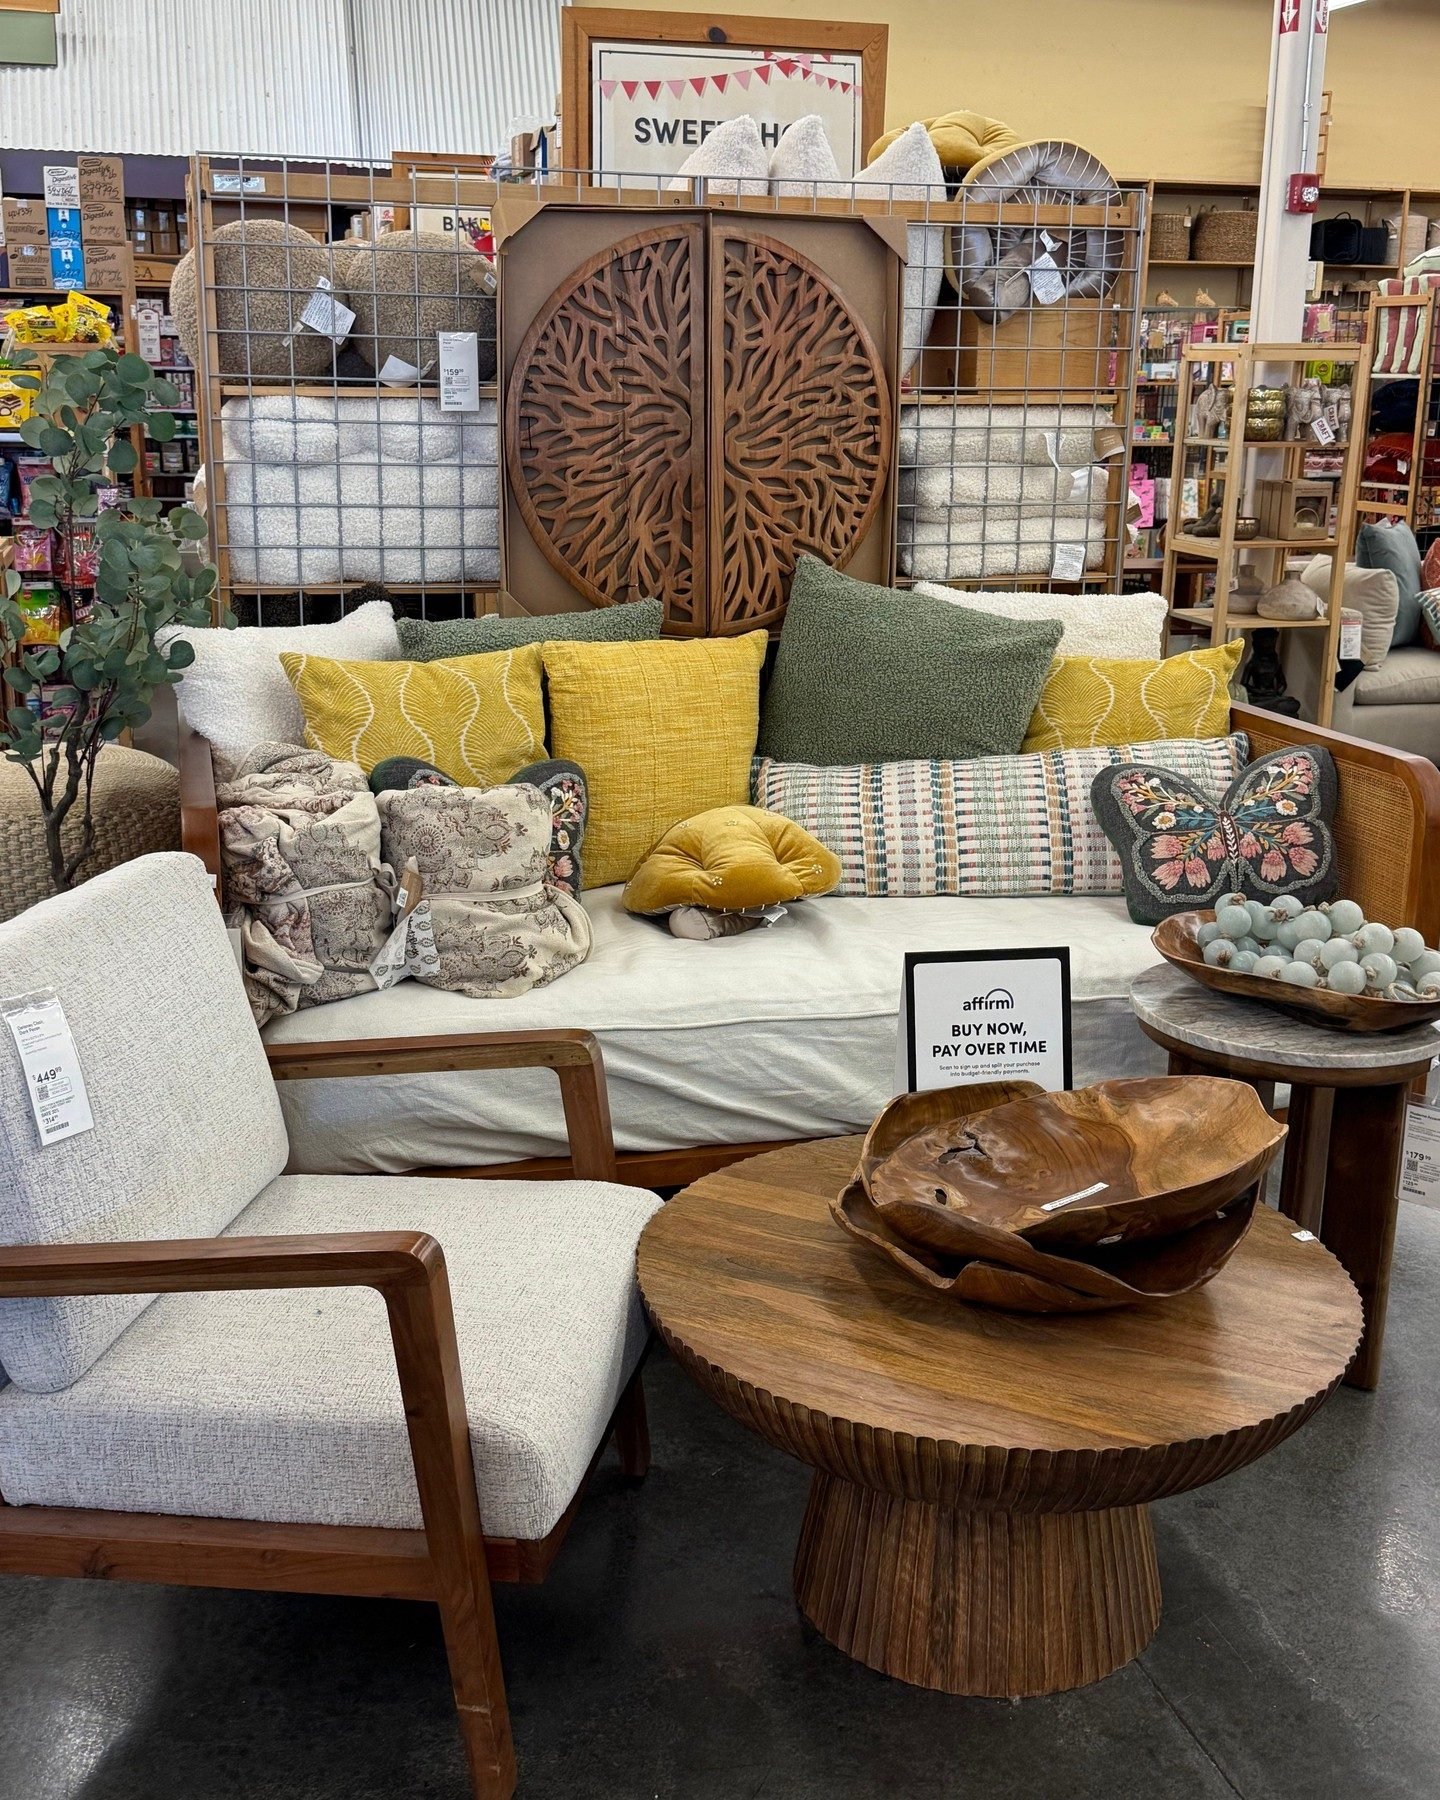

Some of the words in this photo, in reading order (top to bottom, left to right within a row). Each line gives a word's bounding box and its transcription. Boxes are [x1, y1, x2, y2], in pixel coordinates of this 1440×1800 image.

[635, 117, 727, 145] SWEE
[83, 211, 114, 221] Digestive
[86, 254, 117, 265] Digestive
[1316, 420, 1331, 439] CRAFT
[963, 994, 1012, 1011] affirm
[951, 1024, 983, 1037] BUY
[987, 1022, 1027, 1036] NOW,
[932, 1044, 961, 1057] PAY
[965, 1042, 1006, 1056] OVER
[1009, 1040, 1047, 1054] TIME
[961, 1069, 1001, 1077] budget-friendly
